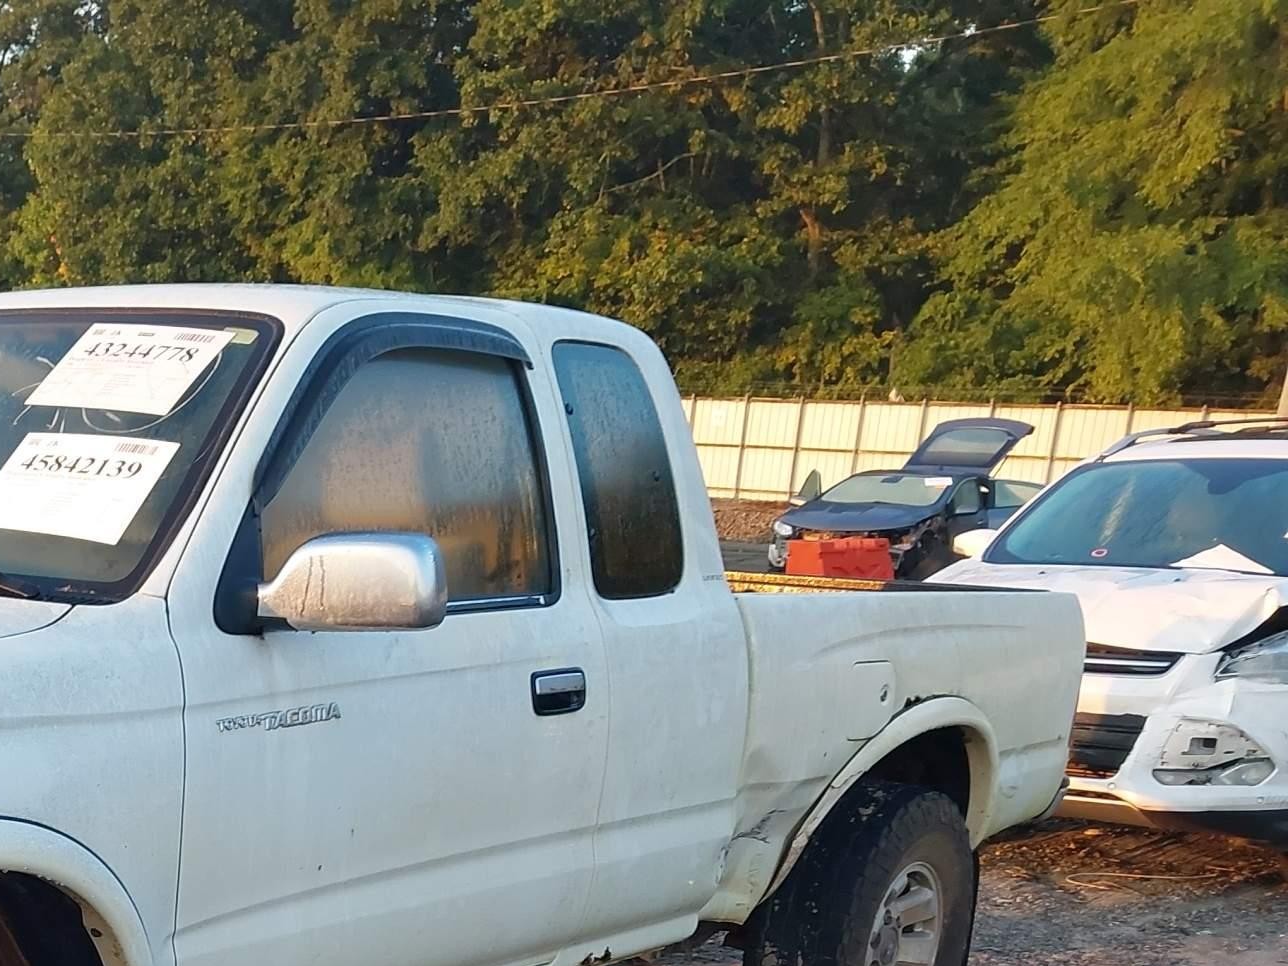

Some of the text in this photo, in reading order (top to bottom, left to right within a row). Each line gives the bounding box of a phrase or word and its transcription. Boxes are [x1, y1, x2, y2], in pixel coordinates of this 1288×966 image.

[84, 342, 200, 362] 43244778
[21, 454, 143, 479] 45842139
[260, 702, 342, 731] TACOMA
